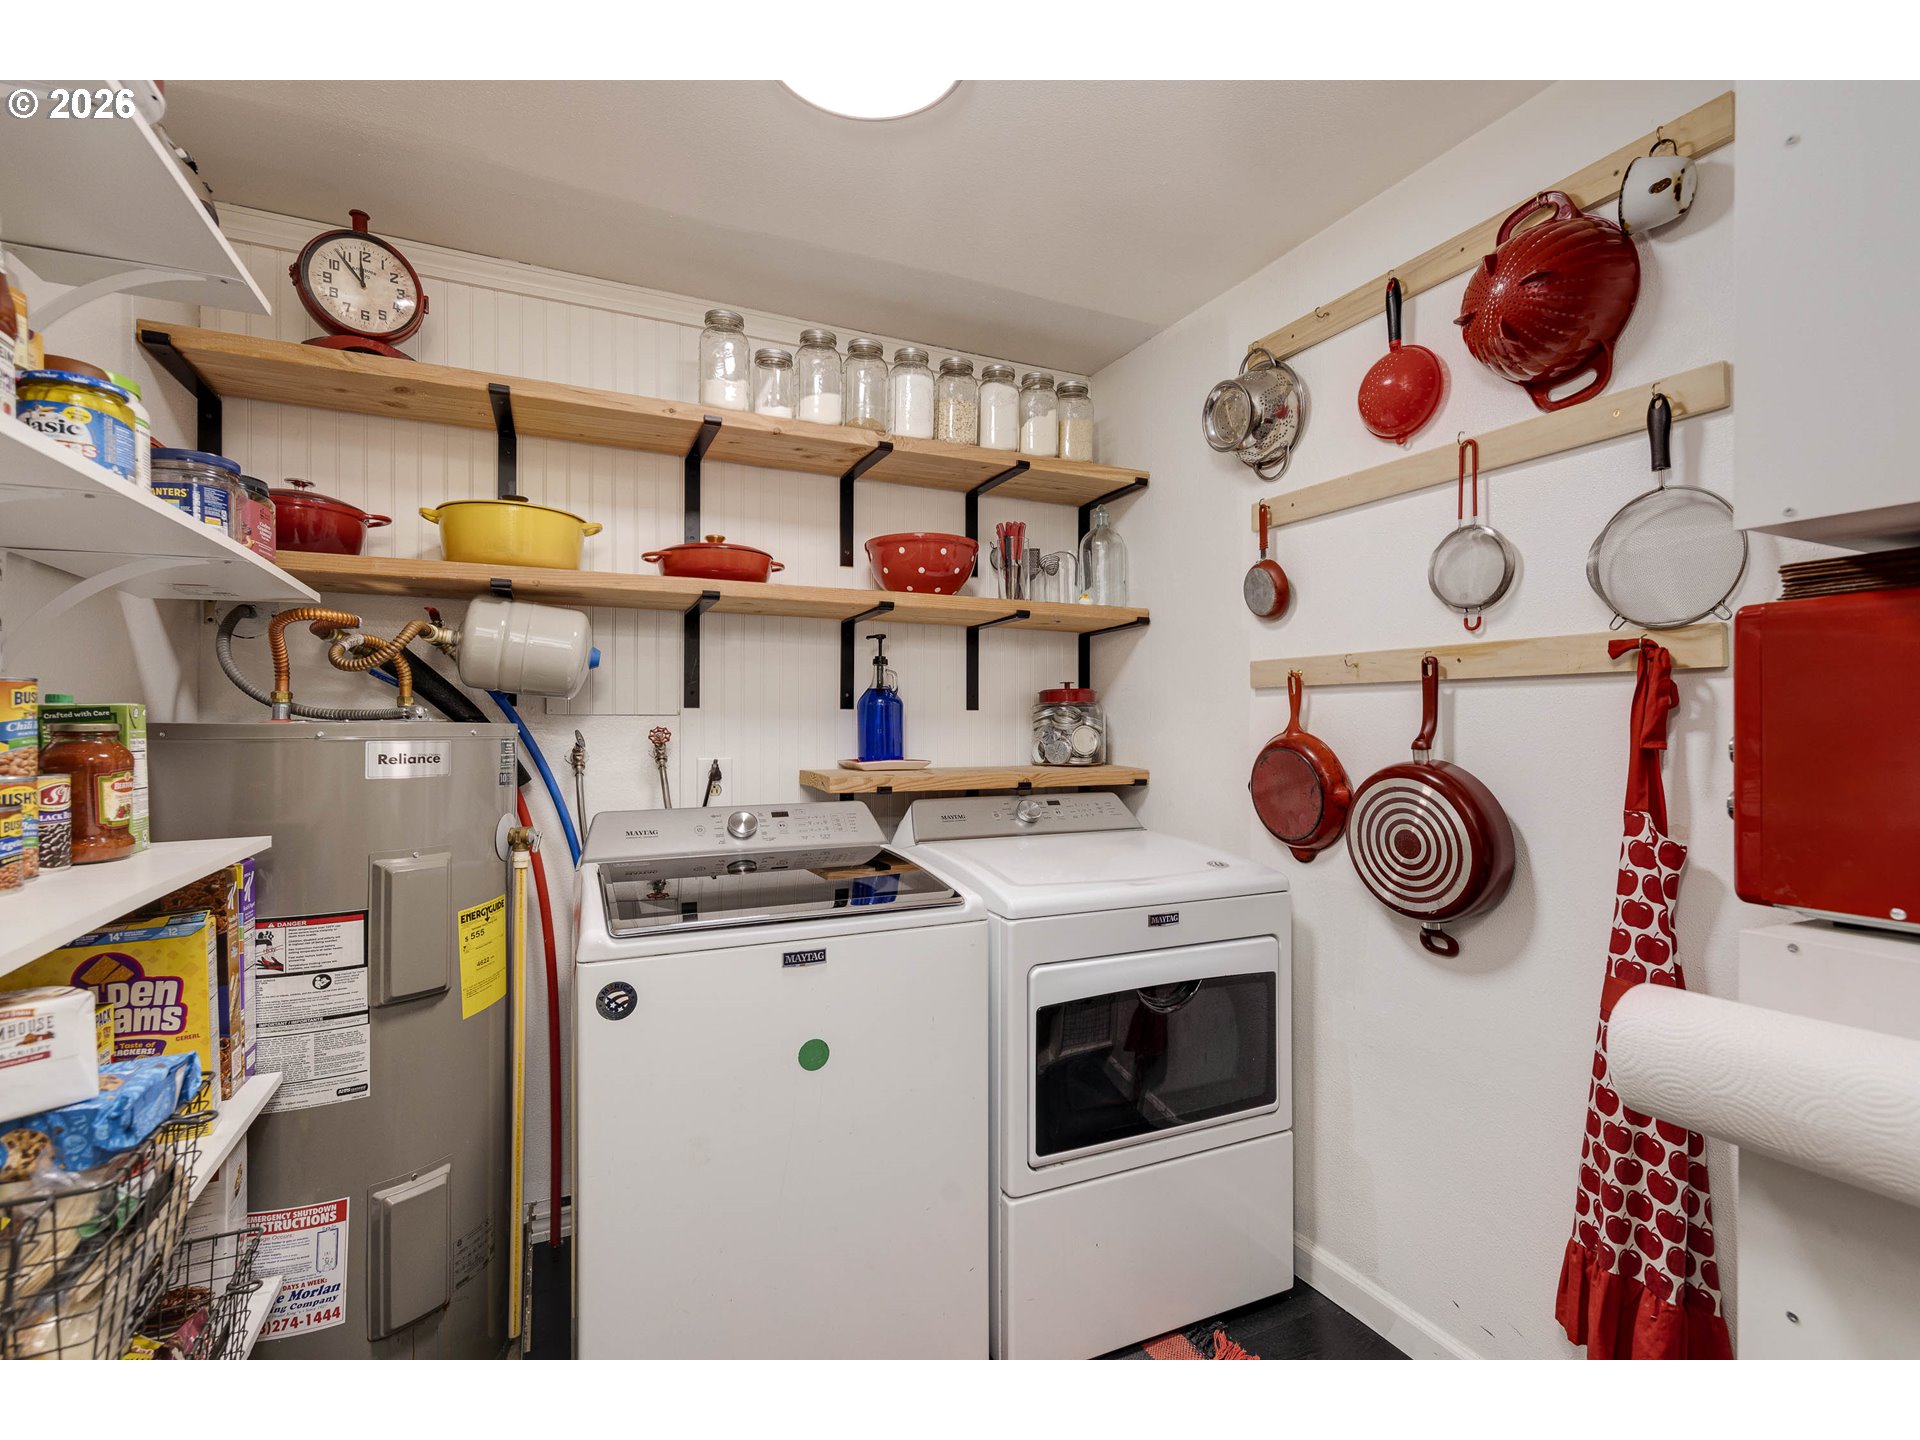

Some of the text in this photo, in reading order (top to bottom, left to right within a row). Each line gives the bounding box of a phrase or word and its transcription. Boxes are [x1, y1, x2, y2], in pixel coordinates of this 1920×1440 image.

[360, 250, 372, 263] 2
[328, 258, 340, 271] 10
[322, 271, 332, 283] 9
[390, 272, 399, 284] 2
[329, 286, 338, 298] 8
[396, 288, 405, 299] 3
[342, 301, 351, 312] 7
[360, 309, 370, 321] 6
[378, 309, 387, 320] 5
[43, 709, 111, 720] Crafted with Care
[377, 753, 441, 765] Reliance
[625, 829, 659, 837] MAYTAG
[276, 920, 307, 928] DANGER
[1151, 915, 1178, 924] MAYTAG
[470, 928, 485, 941] 555
[785, 952, 826, 964] MAYTAG
[598, 983, 634, 1003] AMERICA
[145, 1041, 156, 1049] of
[247, 1204, 337, 1224] EMERGENCY SHUTDOWN
[282, 1284, 300, 1292] DAYS
[306, 1278, 328, 1288] WEEK:
[287, 1282, 342, 1302] Morlan
[289, 1294, 340, 1310] Company
